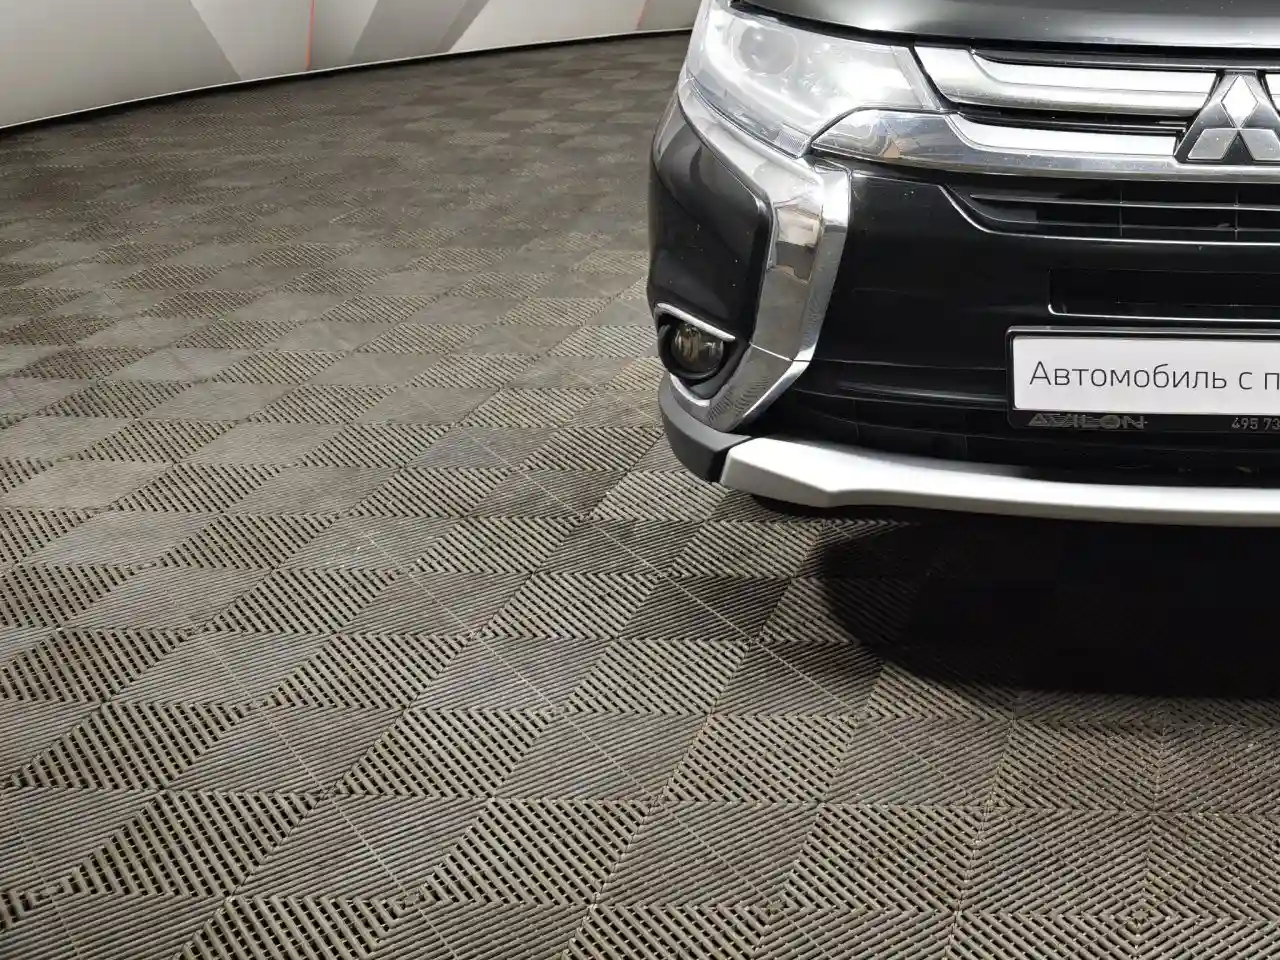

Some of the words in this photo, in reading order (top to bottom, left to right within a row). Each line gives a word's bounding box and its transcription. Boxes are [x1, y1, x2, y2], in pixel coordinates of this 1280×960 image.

[1029, 360, 1228, 389] Автомобиль
[1238, 371, 1254, 390] с
[1231, 417, 1259, 431] 495
